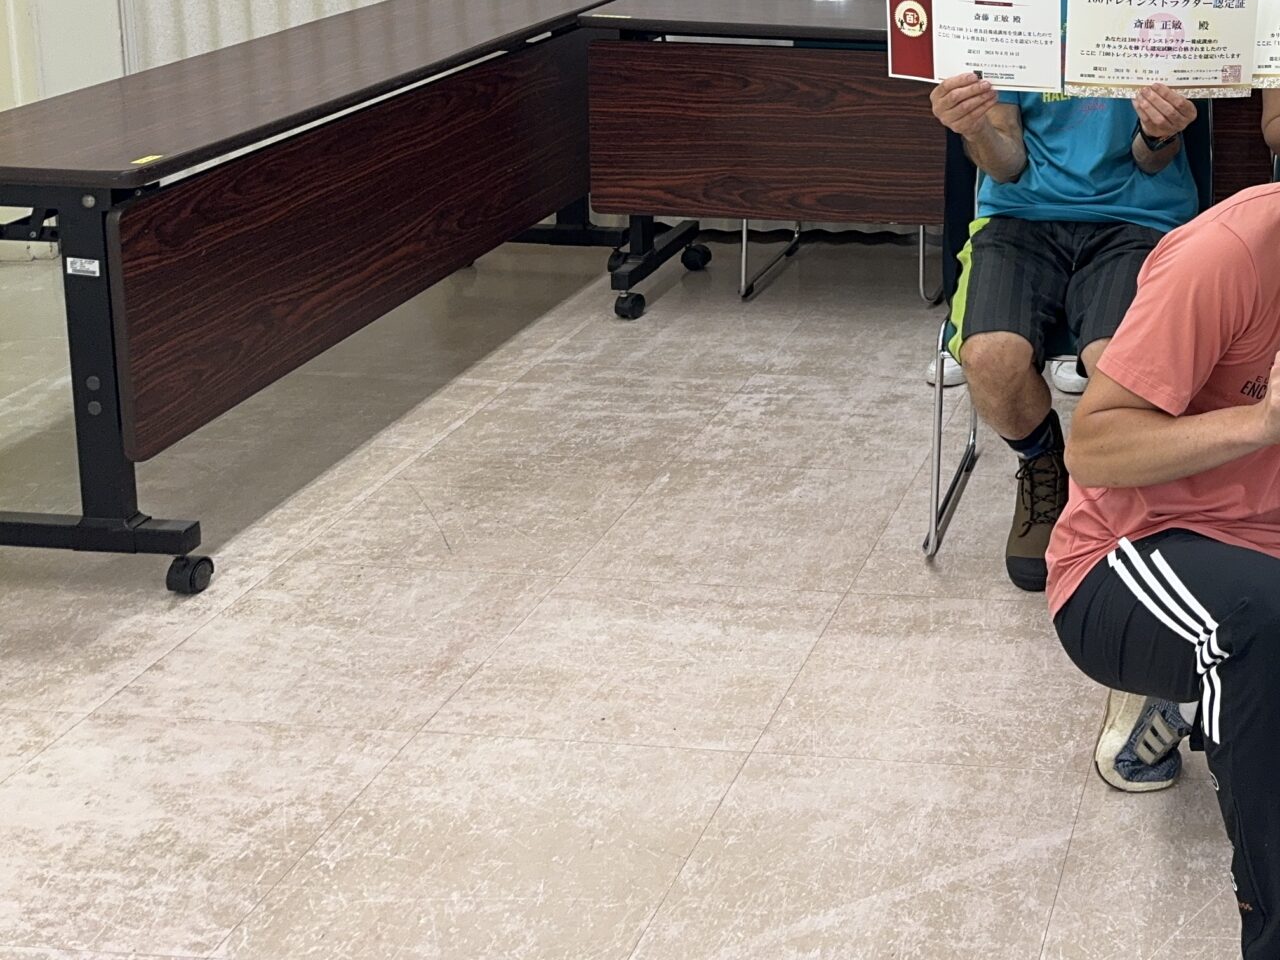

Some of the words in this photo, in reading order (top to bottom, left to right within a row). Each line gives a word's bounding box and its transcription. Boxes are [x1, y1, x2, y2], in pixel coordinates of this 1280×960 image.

[1160, 19, 1182, 30] 正敏
[1198, 20, 1210, 31] 殿
[1042, 91, 1071, 103] HAL
[1240, 380, 1268, 400] ENC
